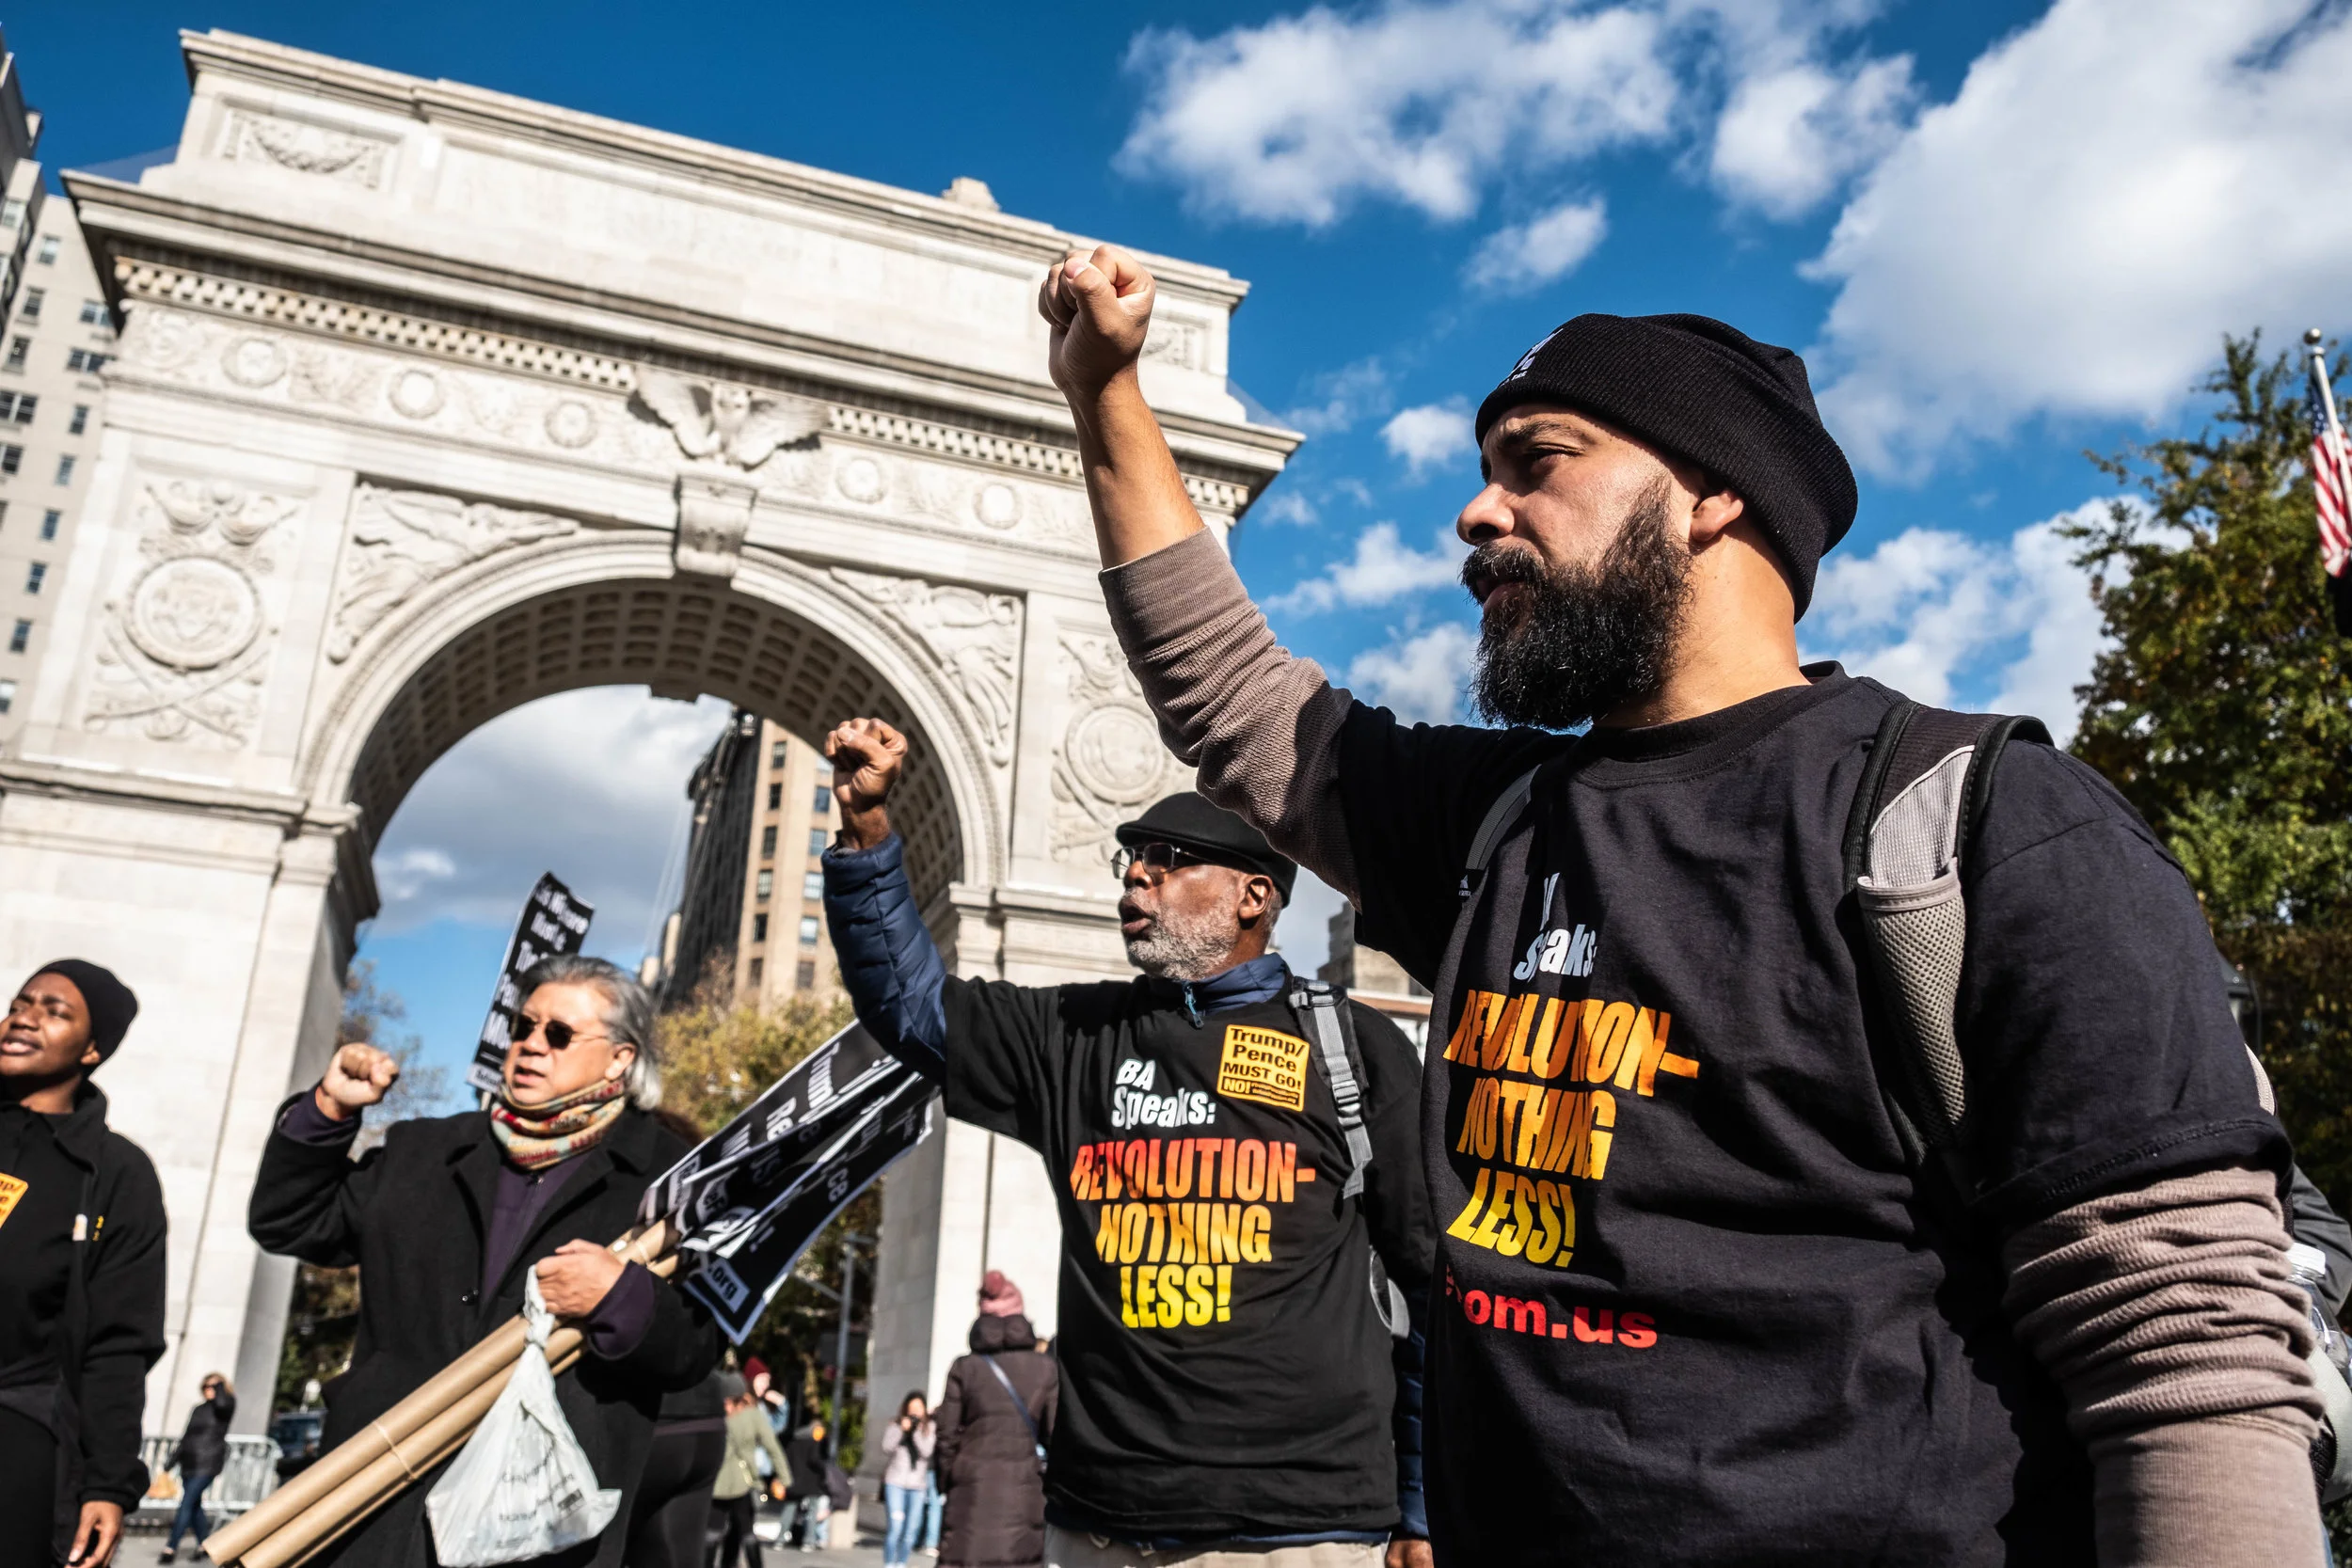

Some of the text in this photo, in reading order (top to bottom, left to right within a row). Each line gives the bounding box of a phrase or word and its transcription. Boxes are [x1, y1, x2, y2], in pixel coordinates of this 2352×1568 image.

[1231, 1028, 1306, 1057] Trump/
[1232, 1044, 1296, 1073] Pence
[1114, 1058, 1156, 1091] BA
[1223, 1062, 1301, 1091] MUST GO!
[1223, 1078, 1251, 1095] NO!
[1110, 1086, 1216, 1130] Speaks:
[1455, 1077, 1616, 1180] NOTHING
[1070, 1137, 1315, 1203] REVOLUTION-
[1095, 1202, 1272, 1264] NOTHING
[1446, 1168, 1576, 1267] LESS!
[1120, 1264, 1232, 1329] LESS!
